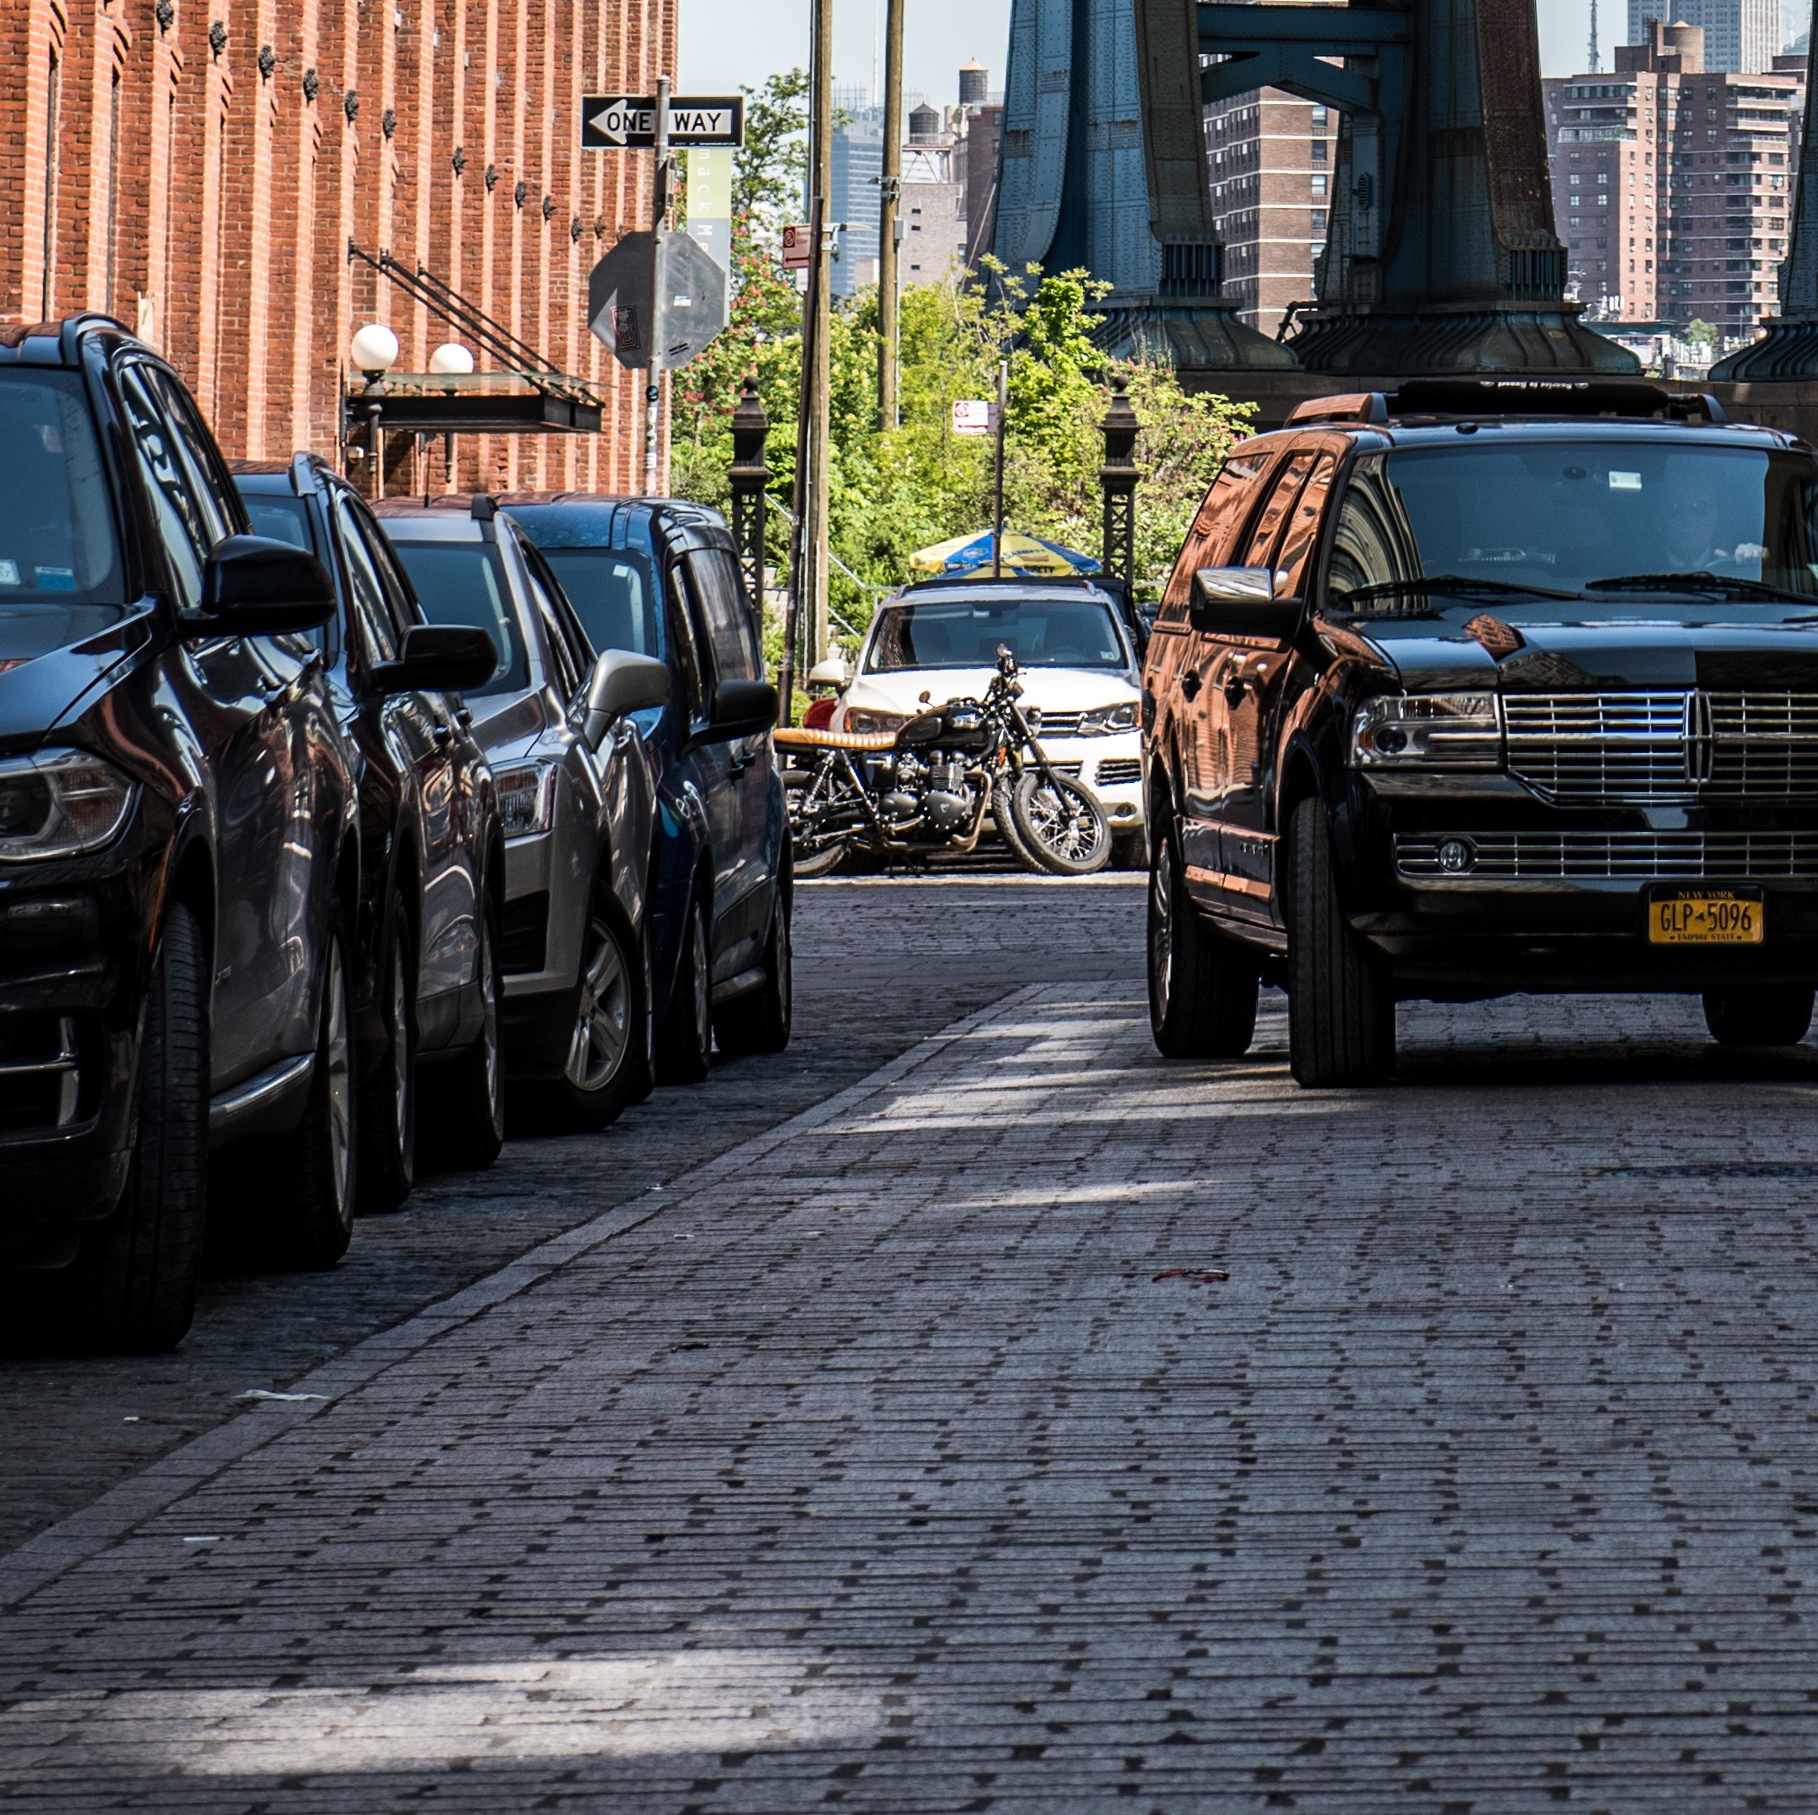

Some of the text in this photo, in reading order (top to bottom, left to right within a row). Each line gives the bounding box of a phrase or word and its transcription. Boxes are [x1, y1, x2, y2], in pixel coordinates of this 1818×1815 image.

[607, 111, 722, 132] ONE WAY
[1678, 890, 1736, 899] NEW YORK
[1677, 933, 1734, 941] EMPIRE STATE
